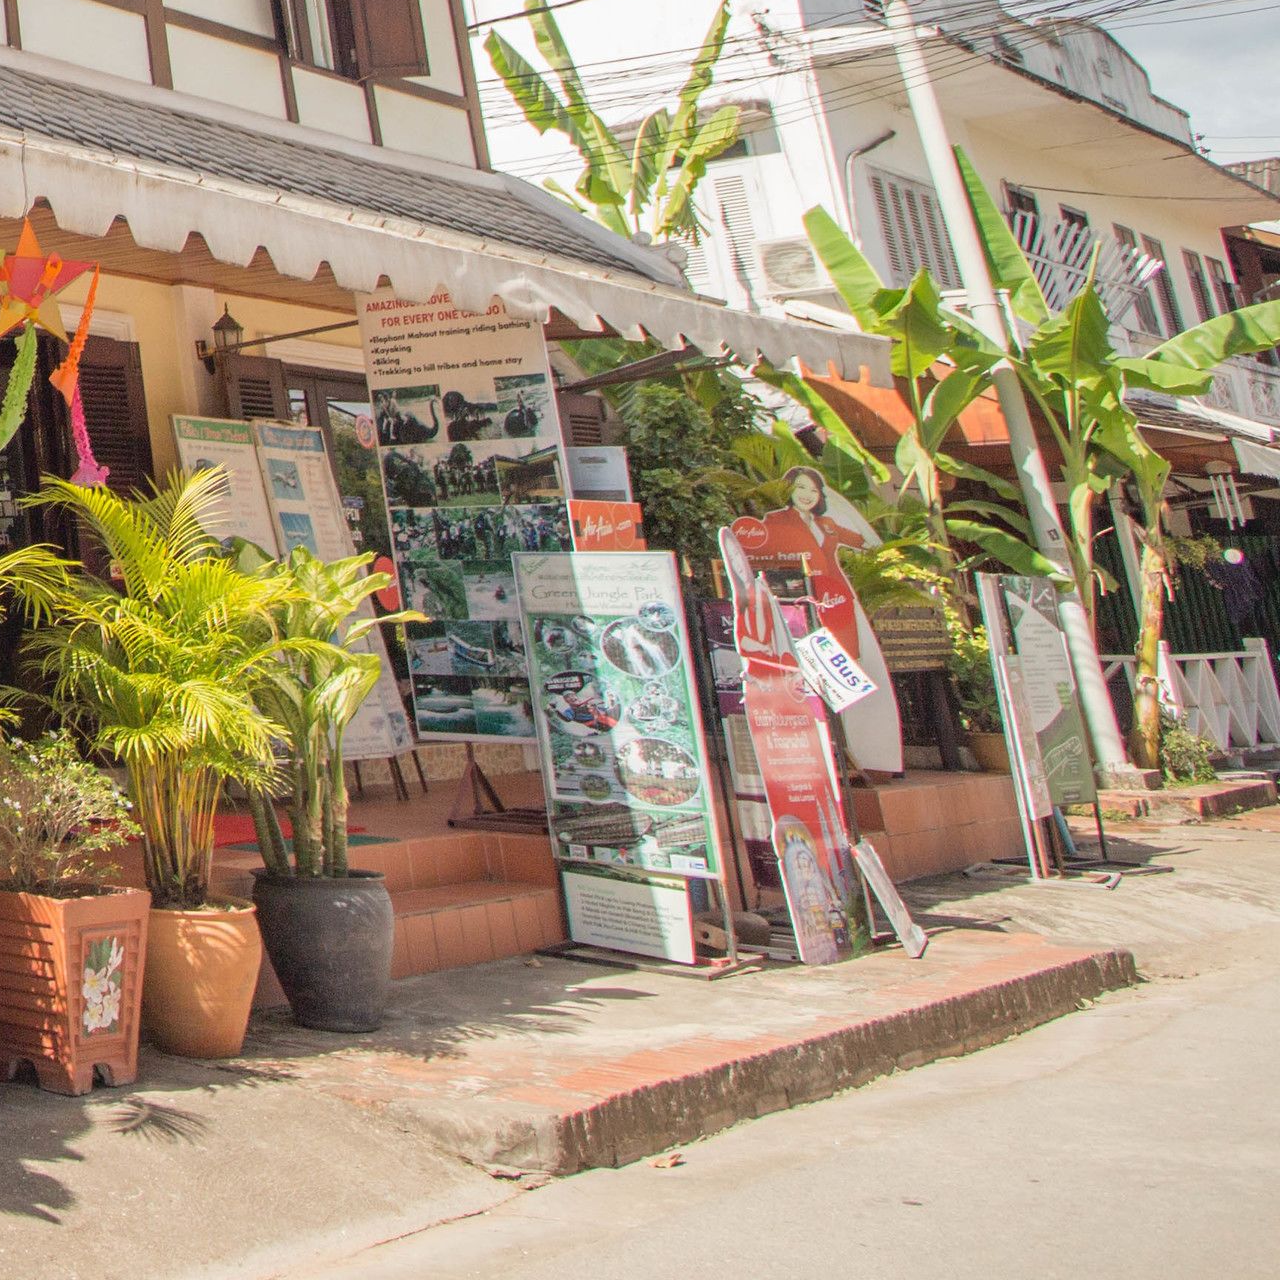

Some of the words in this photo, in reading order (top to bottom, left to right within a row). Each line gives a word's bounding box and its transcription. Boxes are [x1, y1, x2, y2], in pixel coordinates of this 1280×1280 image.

[381, 317, 400, 328] FOR
[403, 313, 434, 326] EVERY
[437, 309, 459, 321] ONE
[374, 345, 412, 356] Kayaking
[378, 368, 412, 377] Trekking
[531, 584, 577, 600] Green
[587, 585, 629, 603] Jungle
[634, 586, 664, 600] Park
